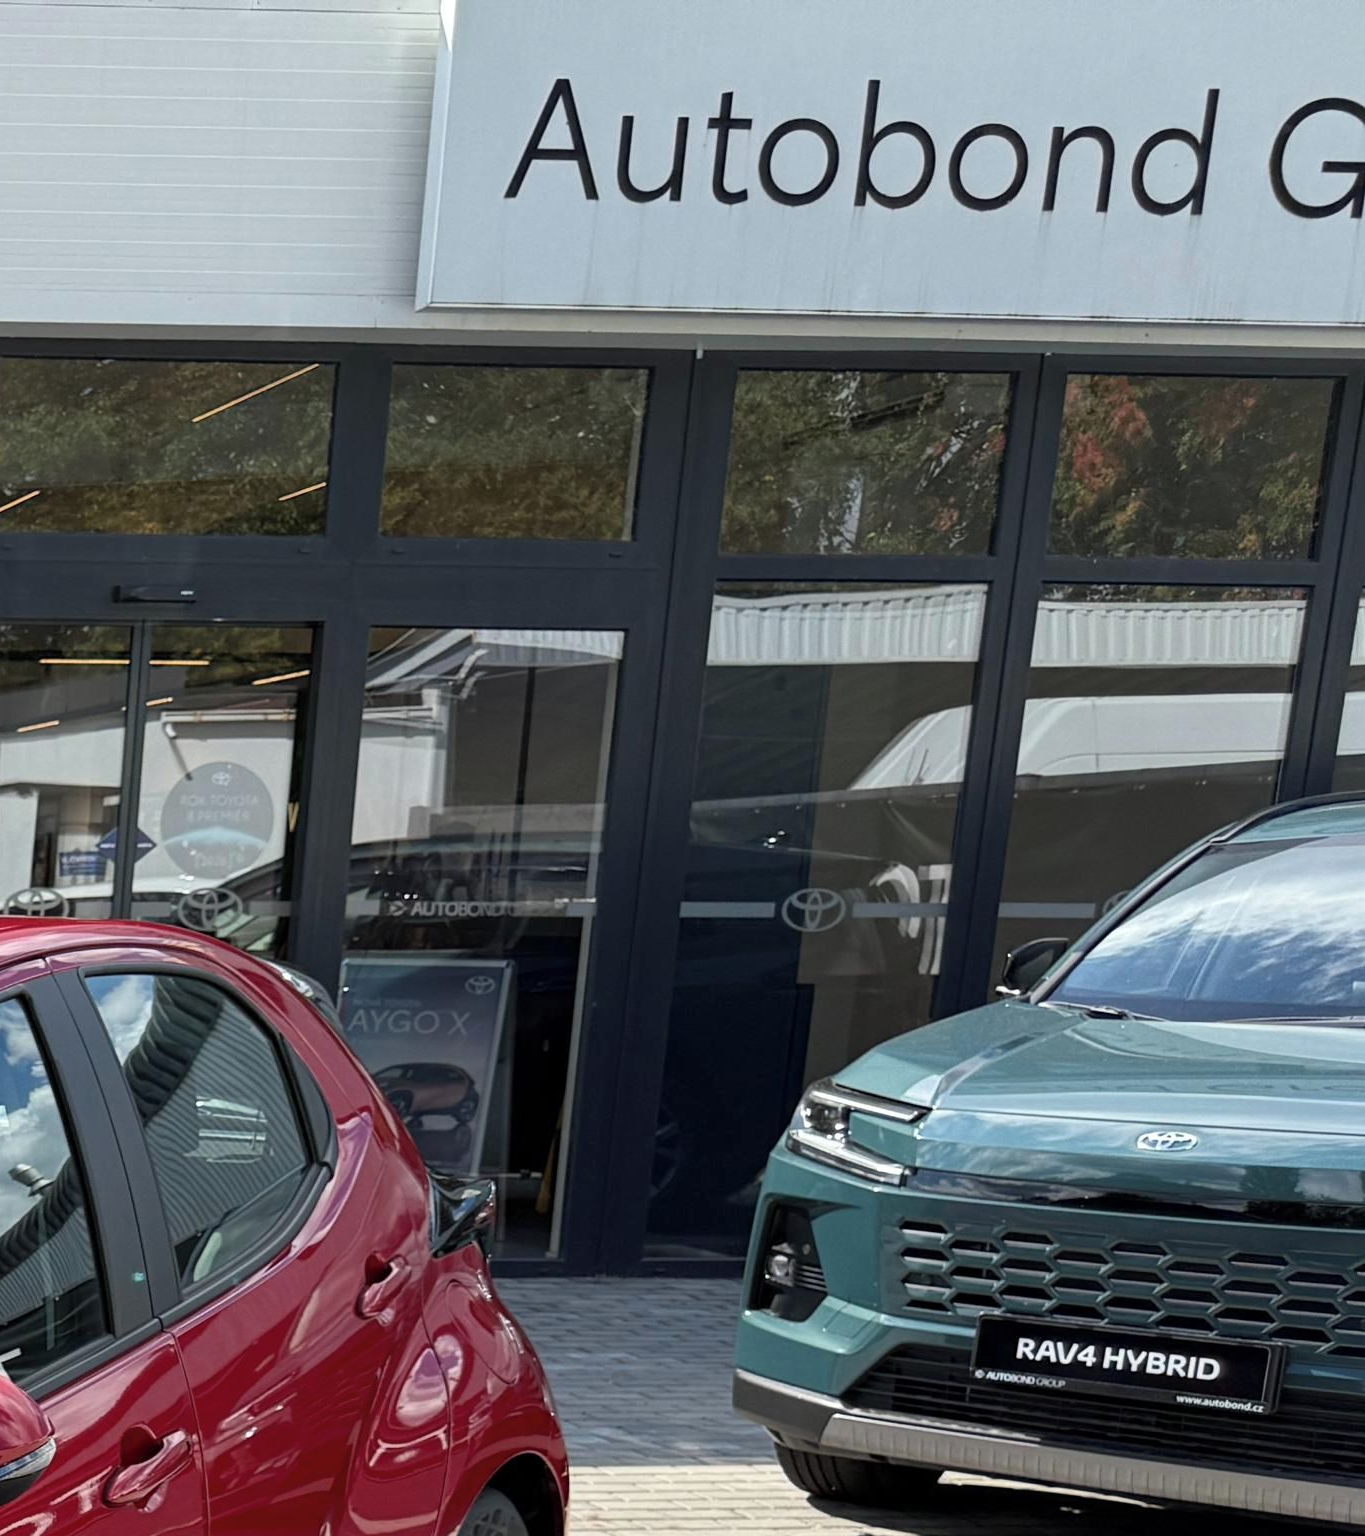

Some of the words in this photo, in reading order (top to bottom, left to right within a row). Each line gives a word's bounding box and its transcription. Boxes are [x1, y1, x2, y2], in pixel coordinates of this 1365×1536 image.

[504, 78, 1221, 217] Autobond
[410, 901, 504, 917] AUTOBOND
[347, 1009, 440, 1034] AYGO
[447, 1010, 472, 1036] X
[1016, 1337, 1097, 1367] RAV4
[1102, 1346, 1221, 1381] HYBRID
[986, 1370, 1035, 1385] AUTOBOND
[1036, 1377, 1066, 1388] GROUP
[1176, 1394, 1264, 1413] www.autobond.cz
